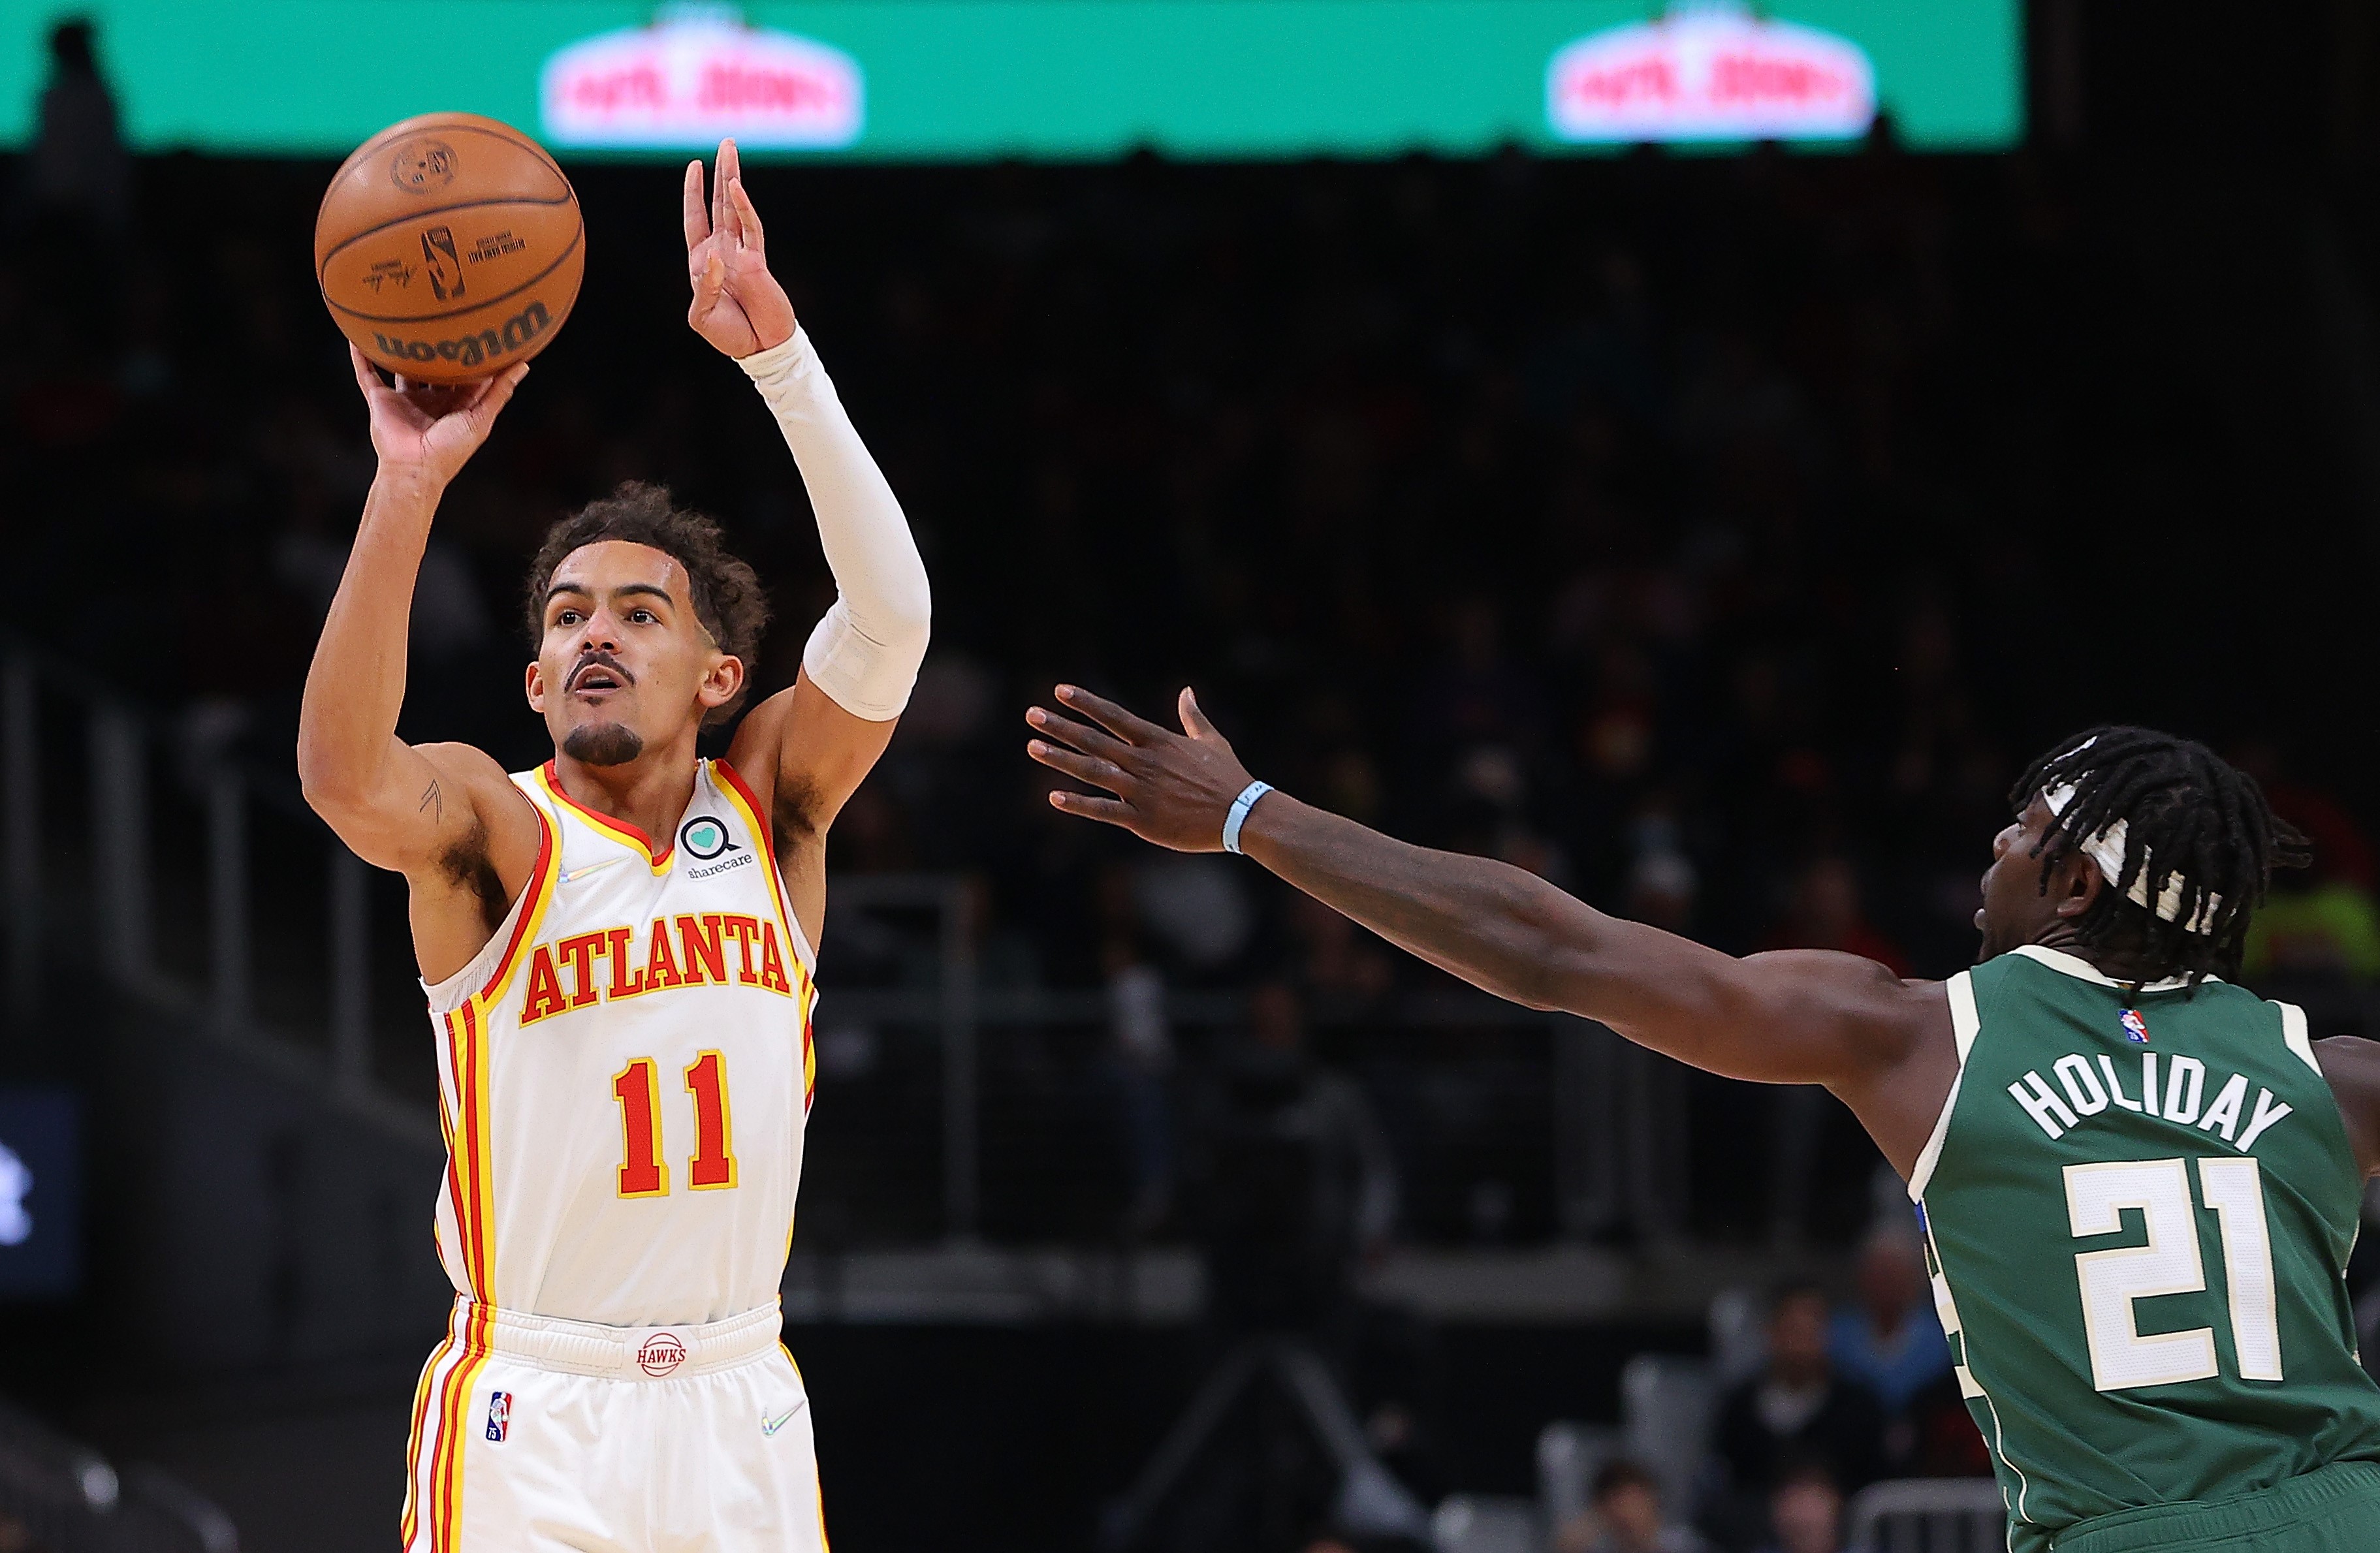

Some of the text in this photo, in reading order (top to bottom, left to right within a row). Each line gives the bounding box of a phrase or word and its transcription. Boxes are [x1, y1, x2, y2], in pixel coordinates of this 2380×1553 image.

[372, 300, 553, 367] Wilson
[688, 854, 752, 879] sharecare
[519, 912, 793, 1029] ATLANTA
[611, 1048, 738, 1199] 11
[2007, 1052, 2294, 1154] HOLIDAY
[2061, 1157, 2284, 1392] 21
[636, 1347, 686, 1364] HAWKS
[488, 1427, 497, 1439] 75
